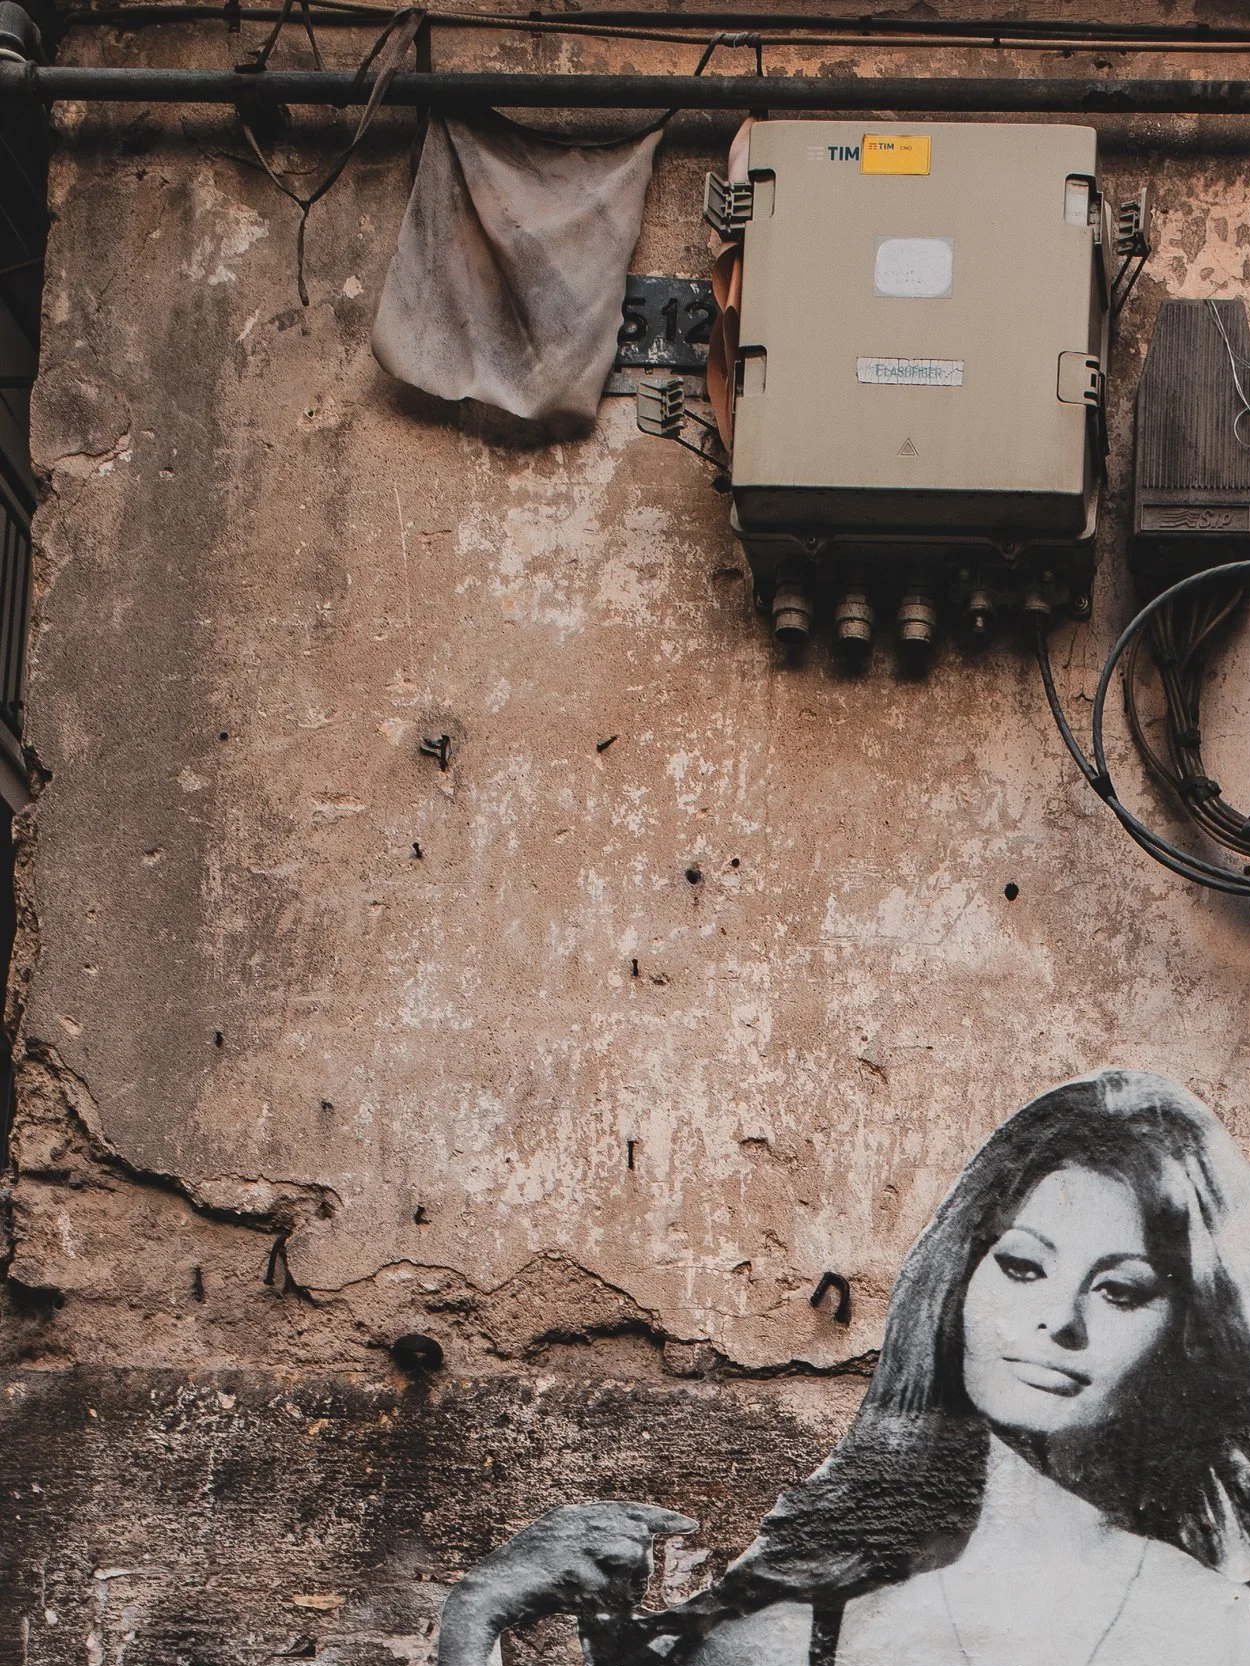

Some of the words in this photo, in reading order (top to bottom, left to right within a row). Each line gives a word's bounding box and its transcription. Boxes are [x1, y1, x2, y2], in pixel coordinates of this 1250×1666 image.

[828, 146, 860, 161] TIM
[878, 142, 895, 150] TIM
[1198, 510, 1233, 528] SIP
